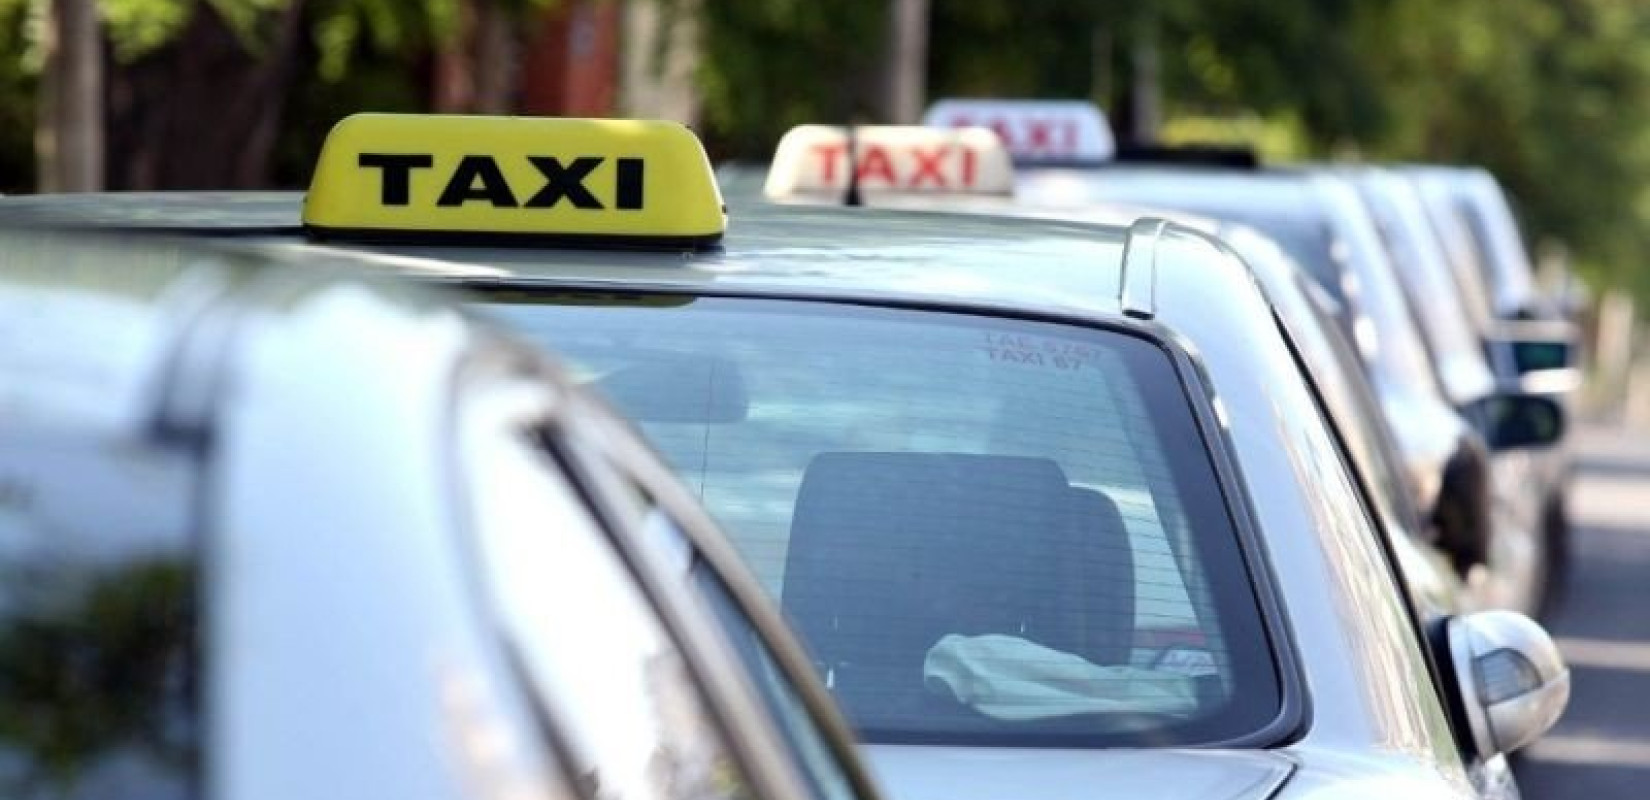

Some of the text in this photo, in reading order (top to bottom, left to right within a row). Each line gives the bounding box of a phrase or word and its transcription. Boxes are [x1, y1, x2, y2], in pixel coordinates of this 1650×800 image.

[358, 153, 644, 210] TAXI
[810, 144, 978, 187] TAXI
[985, 347, 1045, 366] TAXI
